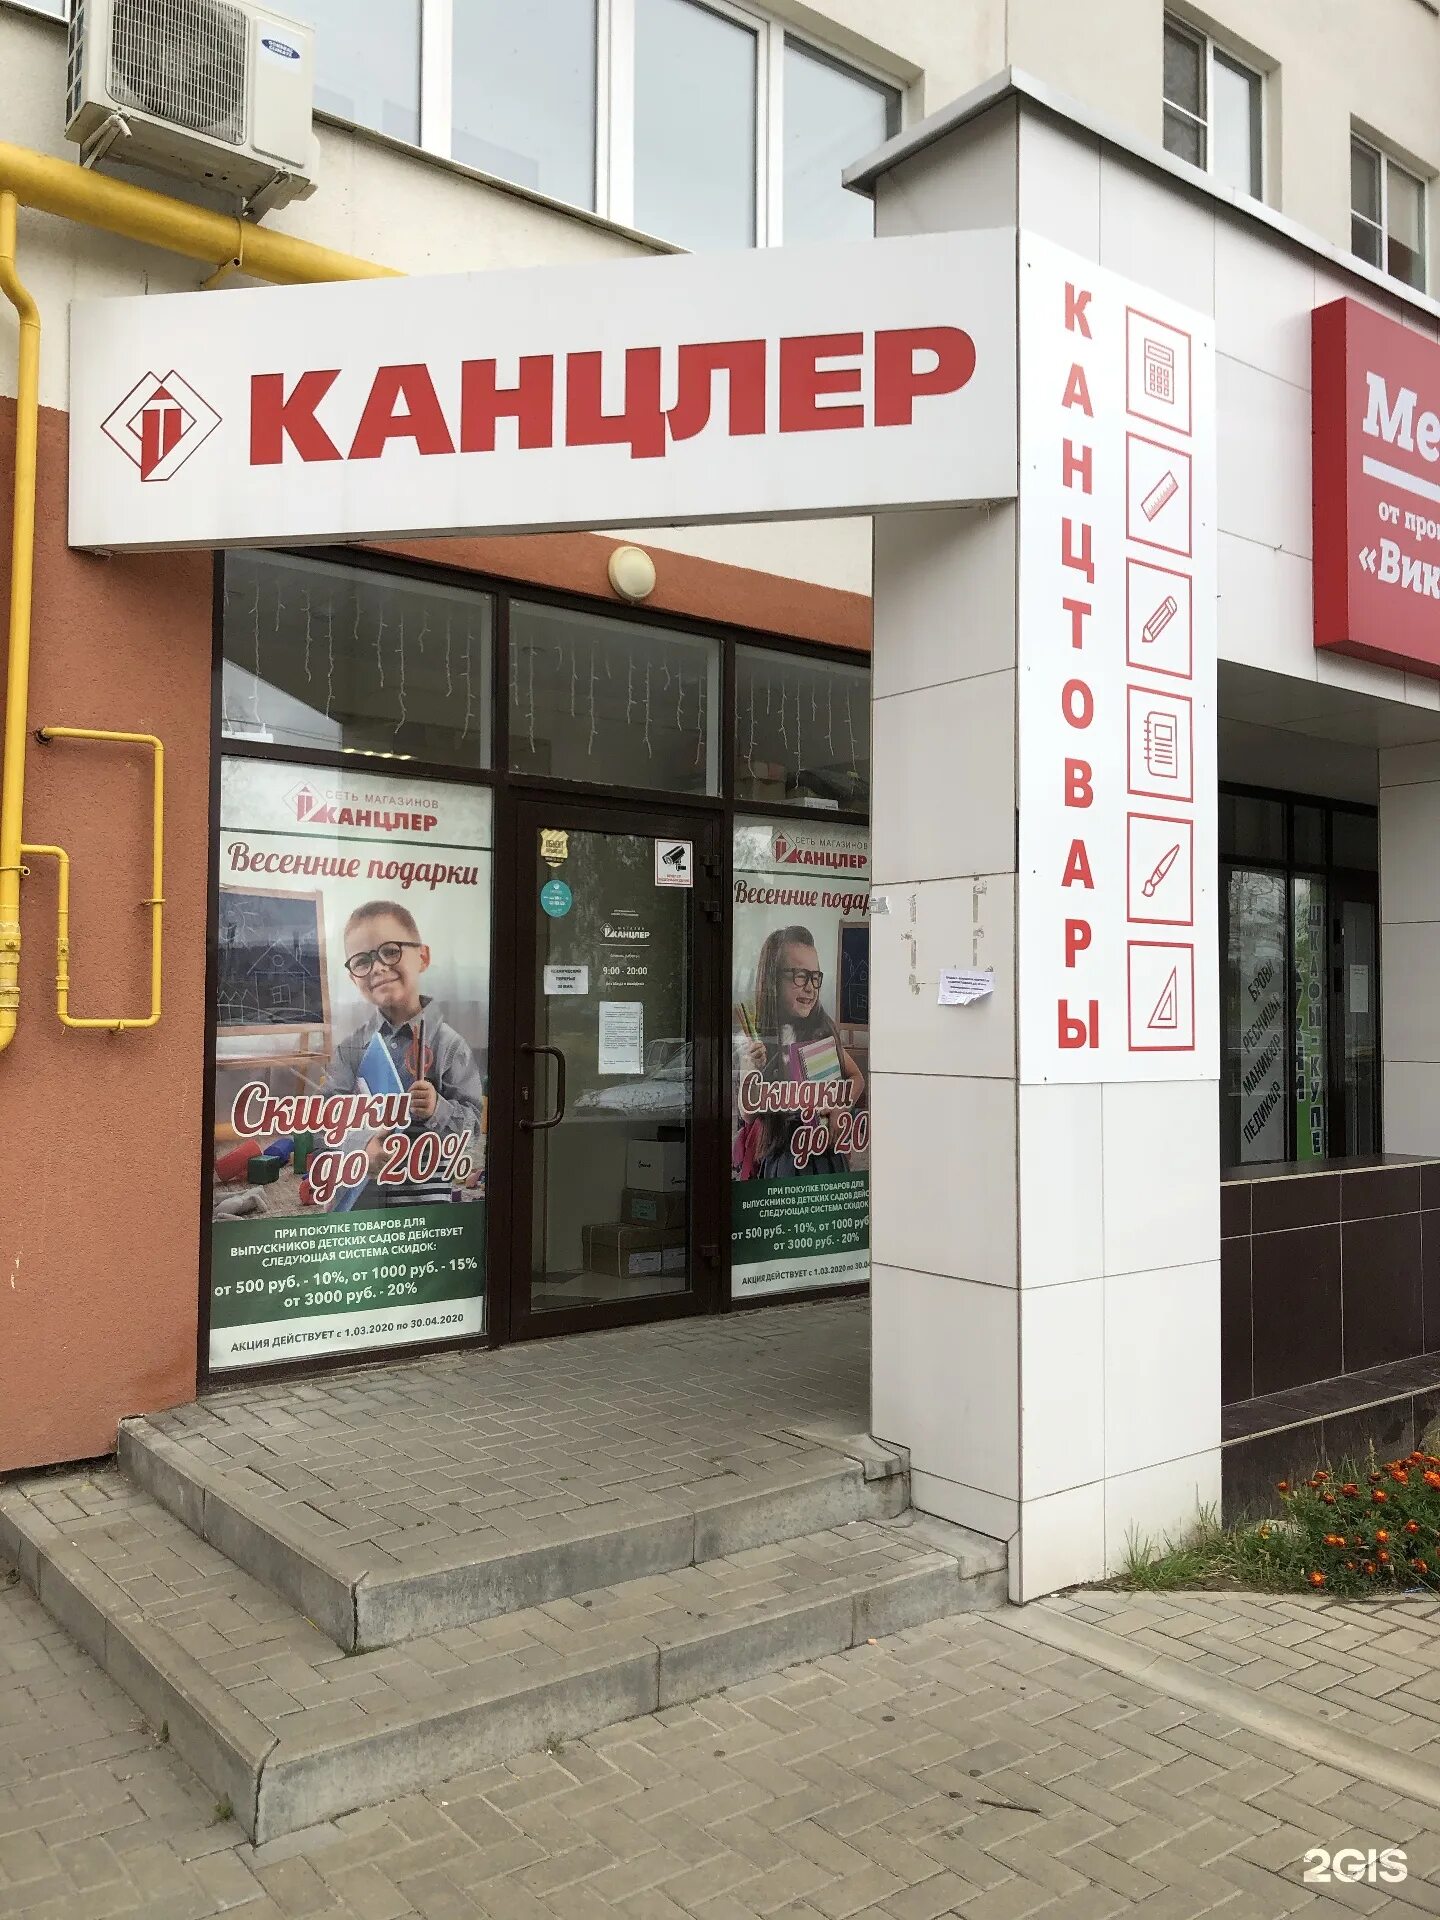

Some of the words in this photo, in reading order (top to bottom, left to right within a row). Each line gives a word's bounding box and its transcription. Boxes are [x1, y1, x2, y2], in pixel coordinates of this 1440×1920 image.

[249, 326, 977, 466] КАНЦЛЕР
[1363, 370, 1440, 462] Ме
[1378, 502, 1400, 525] от
[1404, 511, 1440, 541] про
[1058, 282, 1099, 1049] КАНЦТОВАРЫ
[325, 790, 359, 801] СЕТЬ
[365, 794, 439, 809] МАГАЗИНОВ
[311, 804, 438, 831] КАНЦЛЕР
[795, 837, 816, 846] СЕТЬ
[820, 839, 868, 850] МАГАЗИНОВ
[228, 842, 361, 877] Весенние
[367, 859, 479, 890] подарки
[790, 848, 868, 869] КАНЦЛЕР
[734, 880, 819, 907] Весенние
[611, 930, 650, 939] КАНЦЛЕР
[602, 966, 620, 975] 9:00
[626, 966, 648, 975] 20:00
[1247, 959, 1275, 1002] БРОВИ
[1242, 994, 1282, 1054] РЕСНИЦЫ
[1242, 1033, 1282, 1097] МАНИКЮР
[740, 1070, 854, 1122] Скидки
[232, 1081, 411, 1146] Скидки
[1243, 1081, 1282, 1145] ПЕДИКЮР
[791, 1125, 829, 1169] до
[309, 1150, 368, 1204] до
[377, 1131, 472, 1185] 20%
[742, 1197, 796, 1210] ВЫПУСКНИКОВ
[797, 1194, 830, 1205] ДЕТСКИХ
[830, 1191, 853, 1201] САДОВ
[767, 1187, 784, 1196] ПРИ
[784, 1185, 819, 1196] ПОКУПКЕ
[820, 1182, 850, 1192] ТОВАРОВ
[851, 1180, 865, 1189] ДЛЯ
[759, 1206, 809, 1218] СЛЕДУЮЩАЯ
[810, 1203, 843, 1214] СИСТЕМА
[230, 1240, 316, 1257] ВЫПУСКНИКОВ
[317, 1235, 367, 1249] ДЕТСКИХ
[368, 1232, 406, 1244] САДОВ
[407, 1227, 464, 1241] ДЕЙСТВУЕТ
[274, 1229, 297, 1239] ПРИ
[299, 1223, 351, 1237] ПОКУПКЕ
[353, 1219, 402, 1232] ТОВАРОВ
[403, 1217, 426, 1228] ДЛЯ
[731, 1231, 744, 1240] от
[745, 1227, 762, 1239] 500
[763, 1224, 786, 1239] руб.
[793, 1222, 817, 1234] 10%,
[818, 1223, 830, 1231] от
[831, 1218, 853, 1230] 1000
[773, 1242, 785, 1250] от
[787, 1237, 813, 1250] 3000
[815, 1234, 835, 1249] руб.
[841, 1232, 860, 1244] 20%
[262, 1252, 336, 1268] СЛЕДУЮЩАЯ
[338, 1247, 389, 1261] СИСТЕМА
[391, 1242, 437, 1255] СКИДОК:
[214, 1285, 231, 1297] от
[235, 1279, 264, 1294] 500
[268, 1274, 300, 1294] руб.
[313, 1271, 348, 1286] 10%,
[352, 1271, 368, 1281] от
[372, 1264, 407, 1279] 1000
[410, 1260, 439, 1278] руб.
[449, 1257, 478, 1271] 15%
[741, 1276, 766, 1285] АКЦИЯ
[766, 1270, 808, 1282] ДЕЙСТВУЕТ
[814, 1265, 846, 1276] 1.03.2020
[283, 1297, 300, 1308] от
[304, 1290, 343, 1306] 3000
[346, 1286, 376, 1304] руб.
[387, 1281, 418, 1297] 20%
[230, 1338, 270, 1352] АКЦИЯ
[271, 1330, 335, 1348] ДЕЙСТВУЕТ
[344, 1322, 394, 1337] 1.03.2020
[410, 1313, 464, 1328] 30.04.2020
